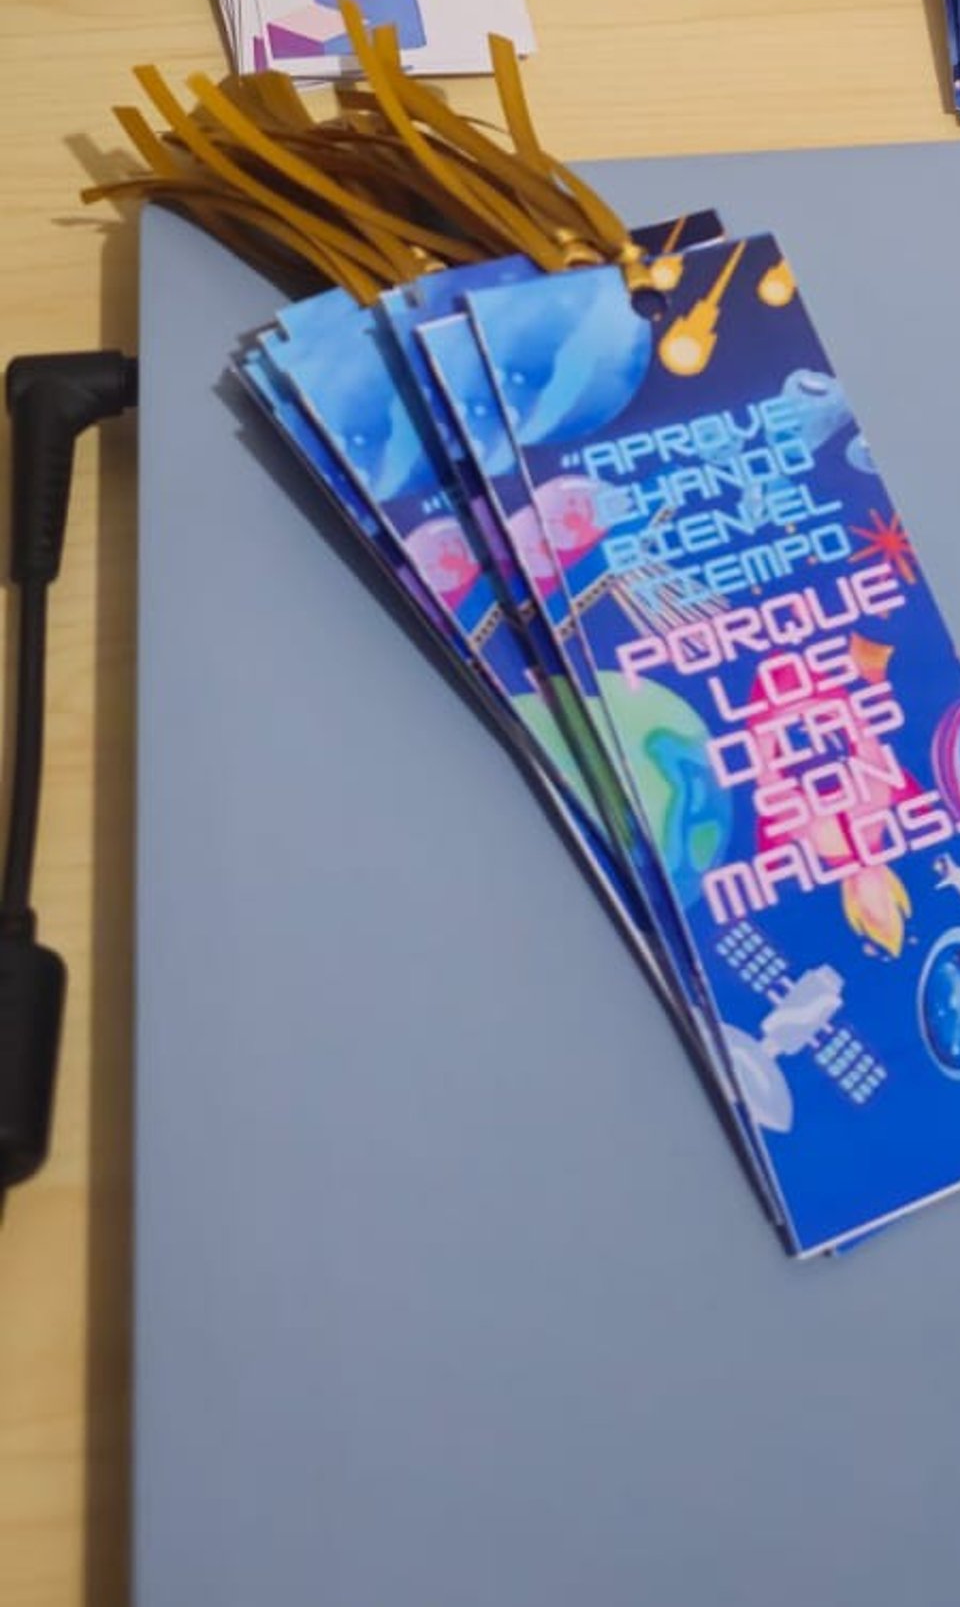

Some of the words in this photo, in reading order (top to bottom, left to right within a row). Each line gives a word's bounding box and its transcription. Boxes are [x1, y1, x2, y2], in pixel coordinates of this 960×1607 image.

[598, 438, 816, 527] CHANDO
[601, 500, 758, 578] BIEN
[765, 484, 843, 526] EL
[629, 523, 852, 616] TIEMPO
[615, 561, 906, 692] PORQUE
[707, 635, 860, 723] LOS
[754, 744, 906, 838] SON
